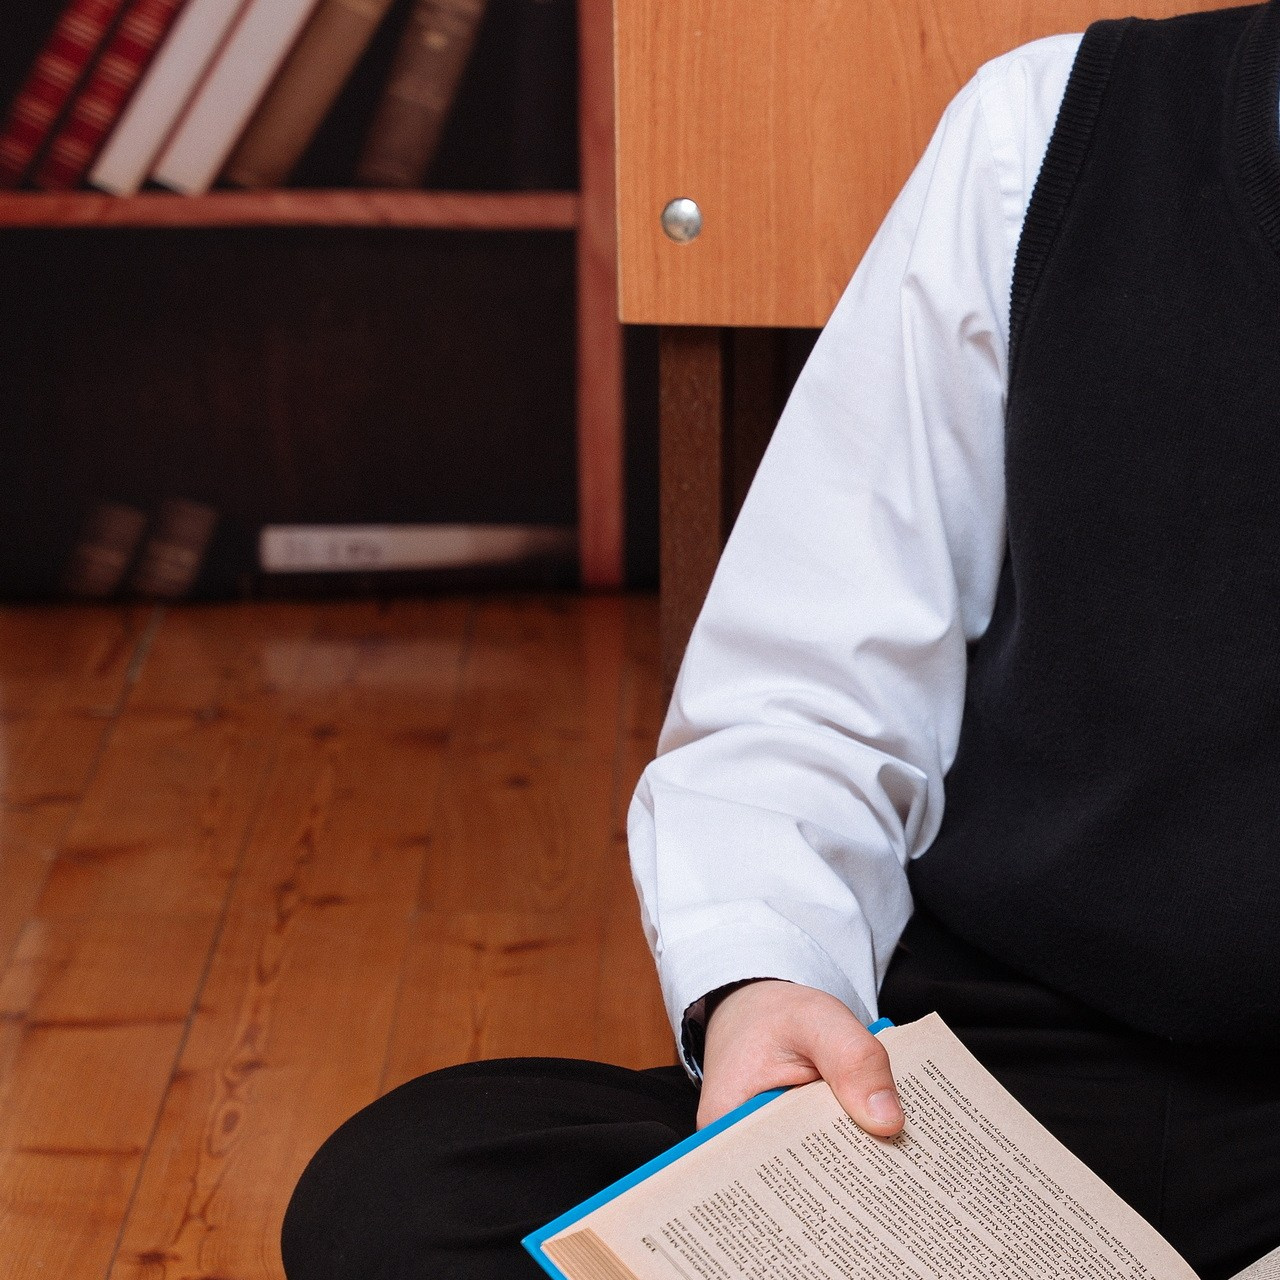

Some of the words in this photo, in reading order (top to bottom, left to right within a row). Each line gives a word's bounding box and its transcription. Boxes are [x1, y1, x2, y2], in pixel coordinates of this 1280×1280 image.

[920, 1063, 937, 1081] про-
[926, 1059, 972, 1107] организации
[891, 1079, 913, 1100] того,
[936, 1081, 978, 1123] смертельно
[912, 1099, 936, 1122] кроме
[811, 1132, 841, 1164] Охотске
[831, 1121, 866, 1157] глазомер-
[978, 1114, 1019, 1152] приступил
[978, 1122, 1011, 1154] государь
[785, 1147, 804, 1167] море
[800, 1140, 820, 1162] суше.
[918, 1125, 975, 1177] удовлетворили
[944, 1130, 991, 1174] кратчайшим
[1012, 1153, 1039, 1178] людей,
[754, 1168, 774, 1190] пере-
[865, 1157, 887, 1177] были
[991, 1173, 1011, 1192] быть
[1032, 1163, 1065, 1194] болезнь,
[804, 1167, 840, 1205] Охотском
[829, 1173, 856, 1199] только
[846, 1170, 897, 1216] построенной
[888, 1175, 935, 1220] мореходами,
[984, 1186, 1016, 1215] Лужина
[1037, 1178, 1063, 1201] Лахты
[773, 1189, 824, 1242] Козыревским
[856, 1198, 906, 1245] совершались
[967, 1200, 1002, 1231] Америка
[1021, 1202, 1038, 1216] мог
[1037, 1215, 1055, 1232] путь
[1065, 1194, 1098, 1225] тяжелую
[1067, 1206, 1094, 1230] спасая
[846, 1210, 880, 1242] открыли
[855, 1228, 872, 1245] ней.
[907, 1226, 935, 1252] Треска
[1021, 1220, 1062, 1259] Евреинова
[1095, 1229, 1114, 1248] года,
[801, 1228, 830, 1259] России.
[823, 1241, 854, 1272] Иваном
[879, 1241, 906, 1266] Быков
[934, 1220, 987, 1268] составляемые
[1013, 1242, 1047, 1274] сошлася
[1054, 1232, 1088, 1263] морской
[1110, 1236, 1148, 1273] Несмотря
[1112, 1248, 1131, 1265] 1724
[877, 1250, 901, 1271] путях
[905, 1245, 943, 1280] Камчатку
[1061, 1259, 1086, 1280] работ
